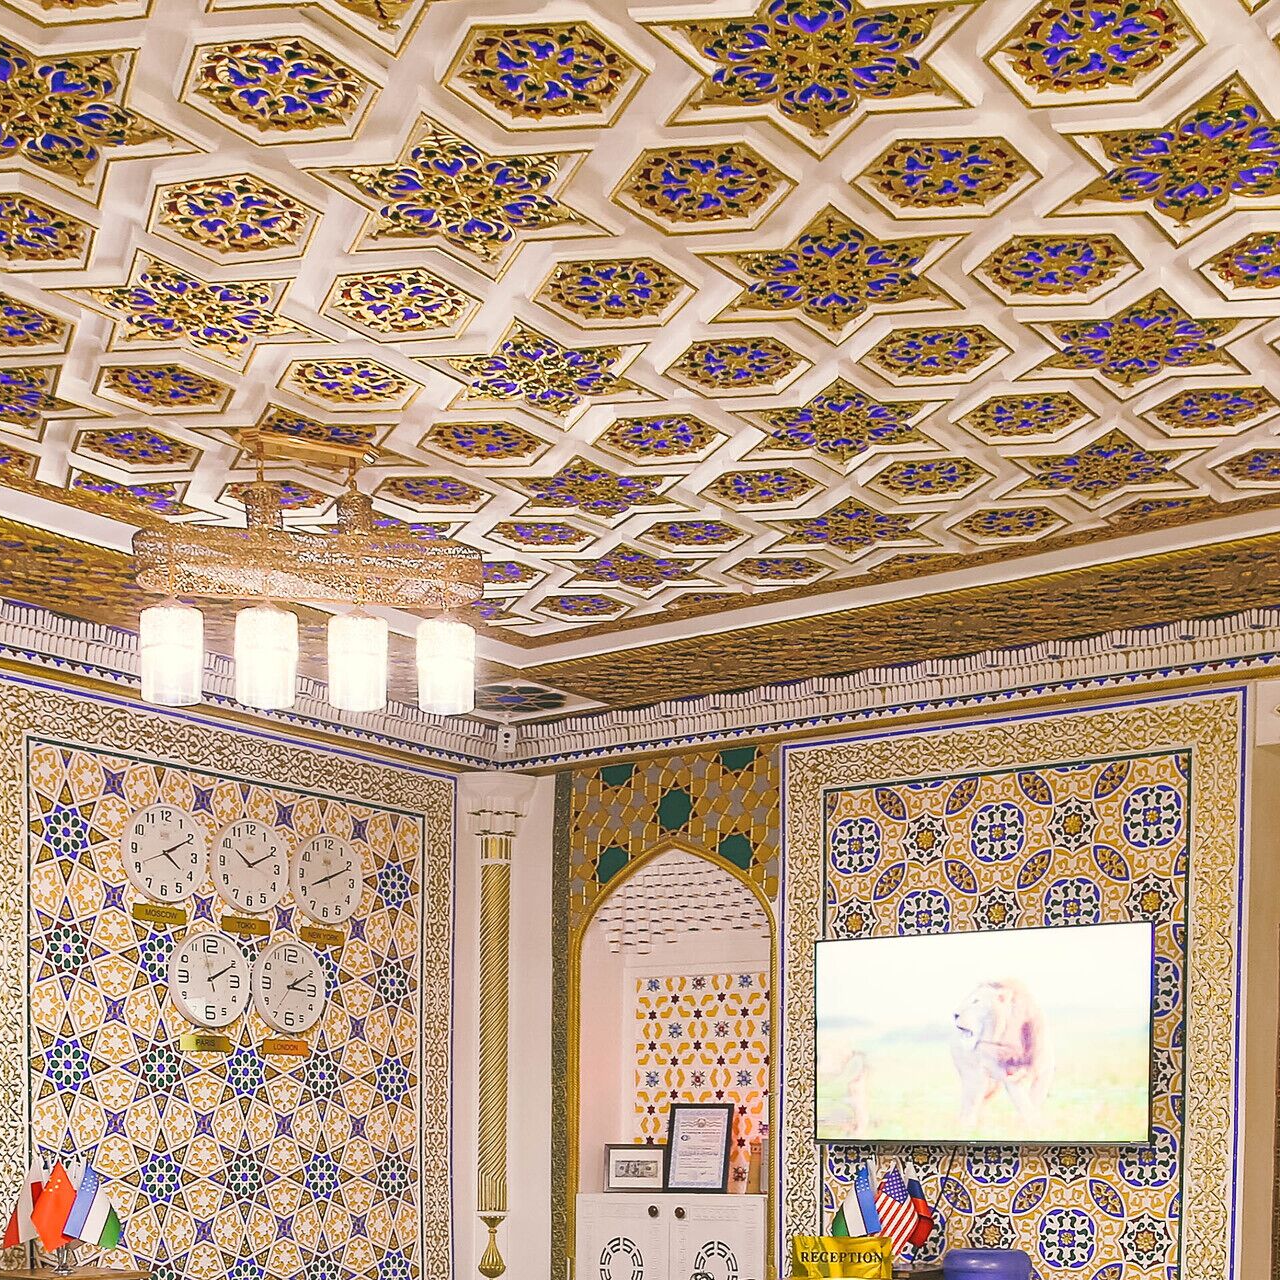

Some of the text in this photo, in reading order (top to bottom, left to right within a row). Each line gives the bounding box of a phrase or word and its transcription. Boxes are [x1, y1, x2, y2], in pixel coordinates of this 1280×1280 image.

[146, 812, 155, 824] 11
[161, 810, 172, 822] 12
[135, 824, 144, 835] 10
[232, 827, 241, 837] 11
[246, 824, 256, 836] 12
[223, 838, 231, 849] 10
[312, 841, 319, 852] 11
[324, 839, 334, 850] 12
[191, 853, 198, 864] 3
[302, 852, 311, 862] 10
[274, 865, 280, 875] 3
[187, 871, 193, 882] 4
[146, 878, 152, 889] 7
[176, 883, 182, 894] 5
[270, 882, 276, 892] 4
[349, 879, 355, 889] 3
[161, 885, 167, 896] 6
[233, 889, 239, 899] 7
[246, 895, 253, 907] 6
[260, 893, 267, 904] 5
[345, 895, 350, 905] 4
[310, 900, 316, 911] 7
[335, 905, 341, 916] 5
[145, 908, 178, 919] MOSCOW
[322, 907, 328, 917] 6
[323, 933, 339, 941] YORK
[202, 939, 219, 954] 12
[284, 948, 298, 963] 12
[229, 975, 240, 989] 3
[307, 984, 317, 998] 3
[205, 1005, 216, 1020] 6
[221, 1008, 227, 1016] 5
[285, 1012, 294, 1026] 6
[299, 1015, 304, 1023] 5
[195, 1039, 215, 1047] PARIS
[273, 1043, 299, 1051] LONDON
[800, 1251, 883, 1264] RECEPTION
